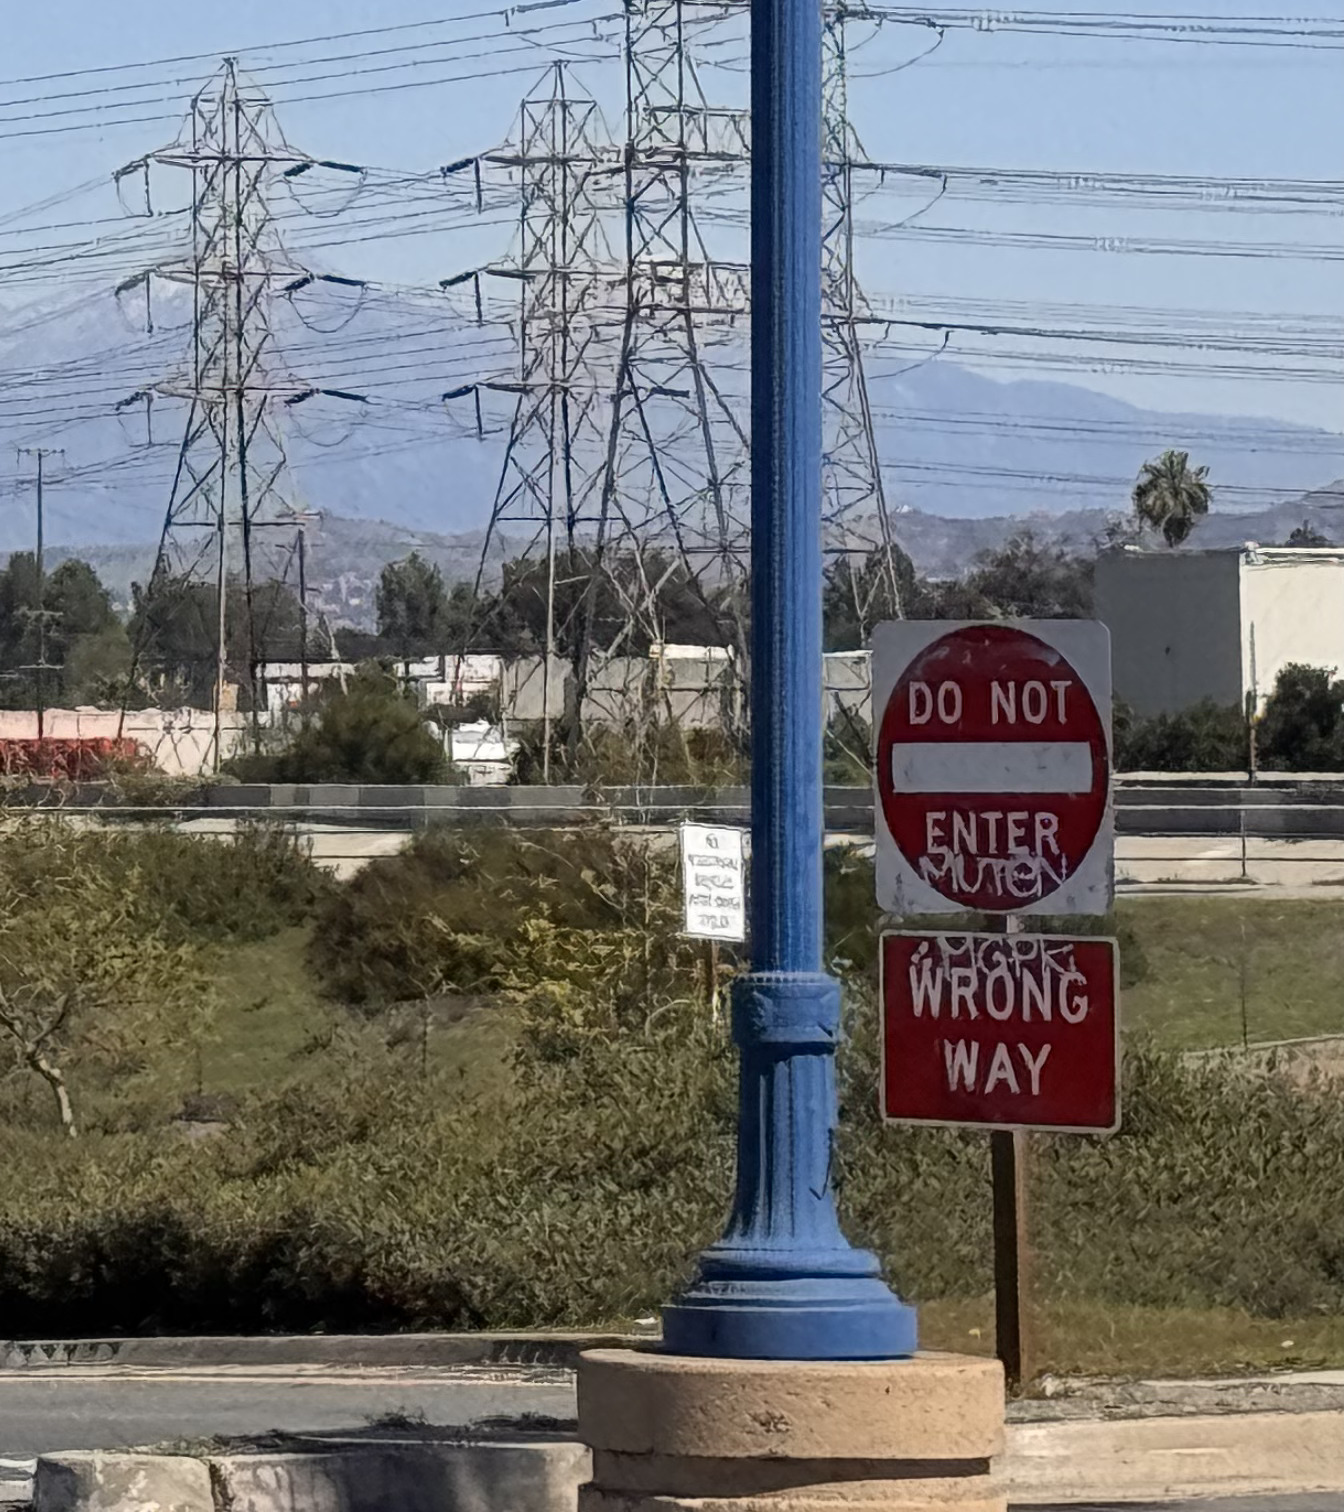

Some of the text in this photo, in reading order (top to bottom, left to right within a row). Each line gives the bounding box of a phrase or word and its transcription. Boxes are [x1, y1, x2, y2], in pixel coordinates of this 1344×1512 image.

[909, 679, 1072, 725] DO NOT
[925, 810, 1060, 856] ENTER
[909, 964, 1090, 1024] WRONG
[943, 1039, 1053, 1096] WAY
